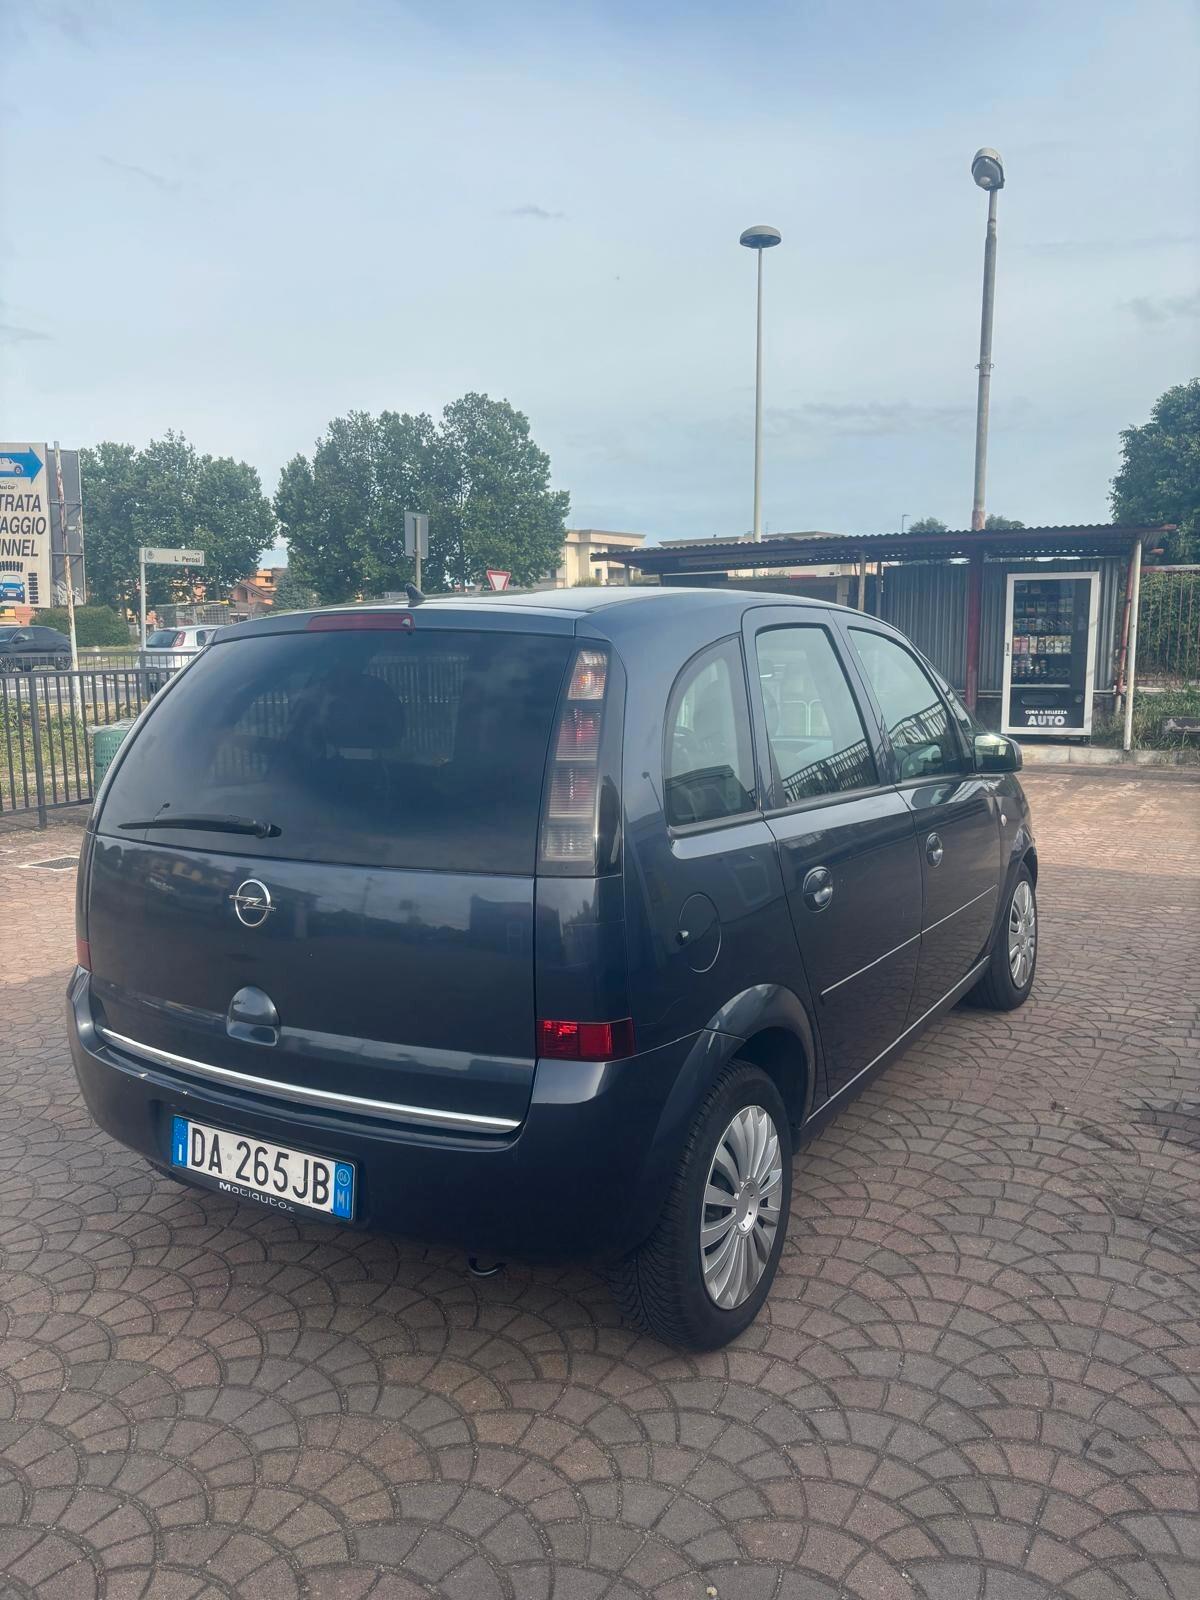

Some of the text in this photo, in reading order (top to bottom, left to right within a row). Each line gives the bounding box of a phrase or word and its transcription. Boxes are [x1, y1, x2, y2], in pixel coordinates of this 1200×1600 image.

[0, 516, 46, 535] AGGIO
[0, 538, 39, 557] NNEL
[1027, 715, 1065, 726] AUTO
[191, 1127, 223, 1175] DA
[336, 1189, 350, 1207] MI
